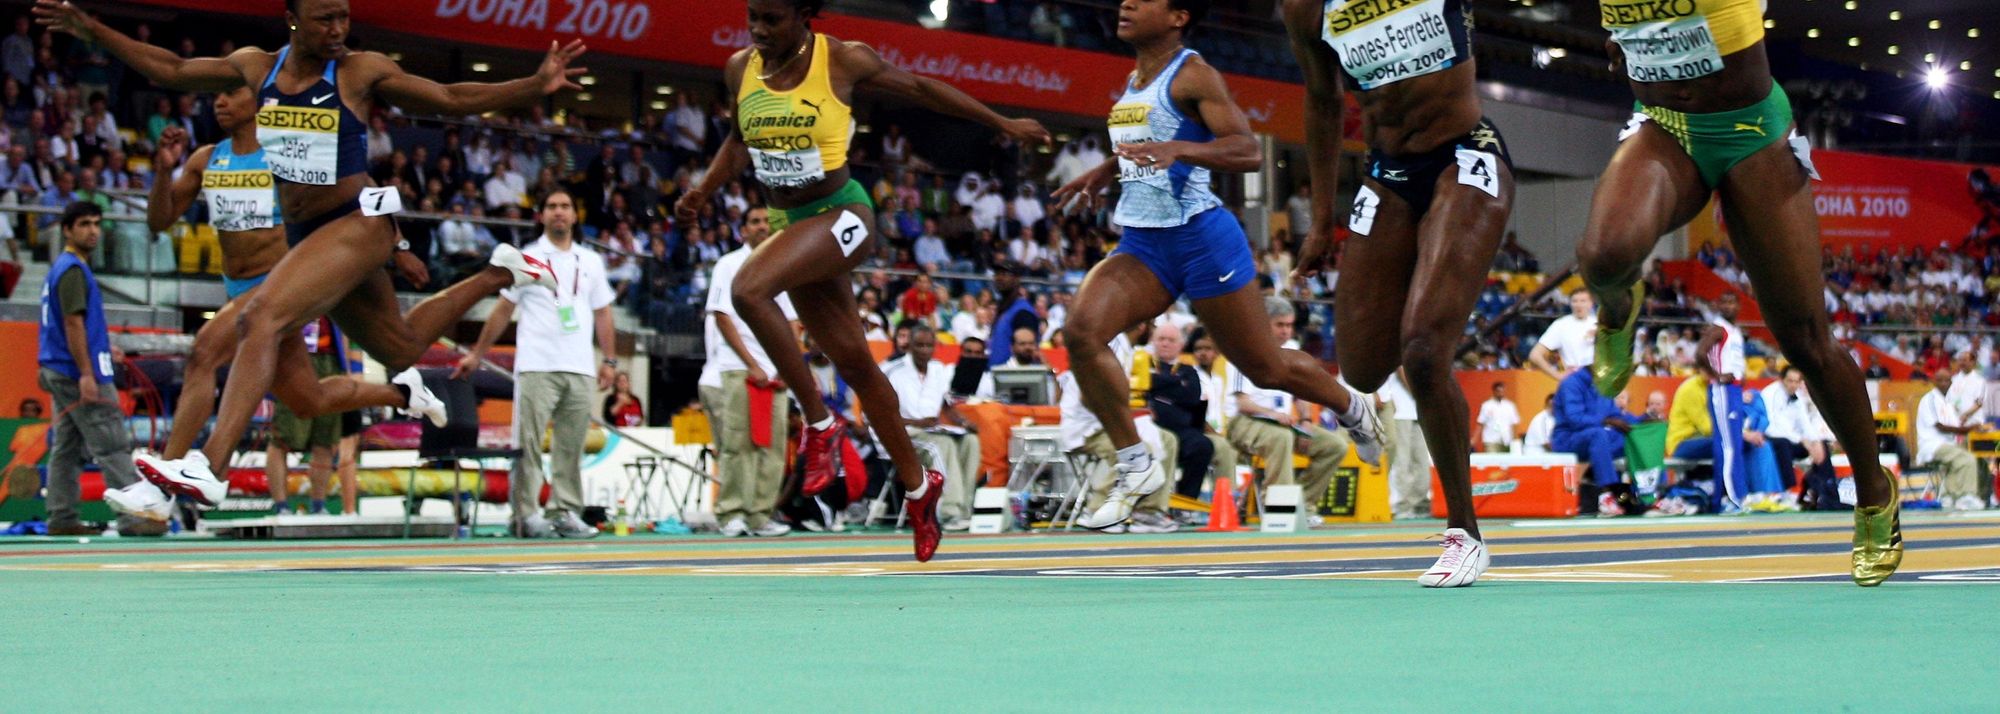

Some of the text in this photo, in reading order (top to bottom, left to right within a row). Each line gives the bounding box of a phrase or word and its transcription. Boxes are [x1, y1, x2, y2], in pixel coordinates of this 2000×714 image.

[556, 0, 650, 41] 2010
[1331, 0, 1420, 33] SEIK
[1601, 0, 1697, 25] SEIKO
[1342, 12, 1446, 70] Jones-Ferrette
[1412, 47, 1447, 71] 2010
[1673, 58, 1714, 79] 2010
[258, 110, 335, 131] SEIKO
[743, 112, 817, 131] jamaica
[280, 136, 312, 160] Jeter
[760, 152, 804, 173] Brooks
[1470, 157, 1492, 188] 4
[204, 173, 272, 189] SEIKO
[300, 169, 328, 184] 2010
[215, 193, 258, 216] Sturrup
[369, 190, 388, 212] 7
[1814, 196, 1910, 218] OHA 2010
[841, 224, 860, 246] 6
